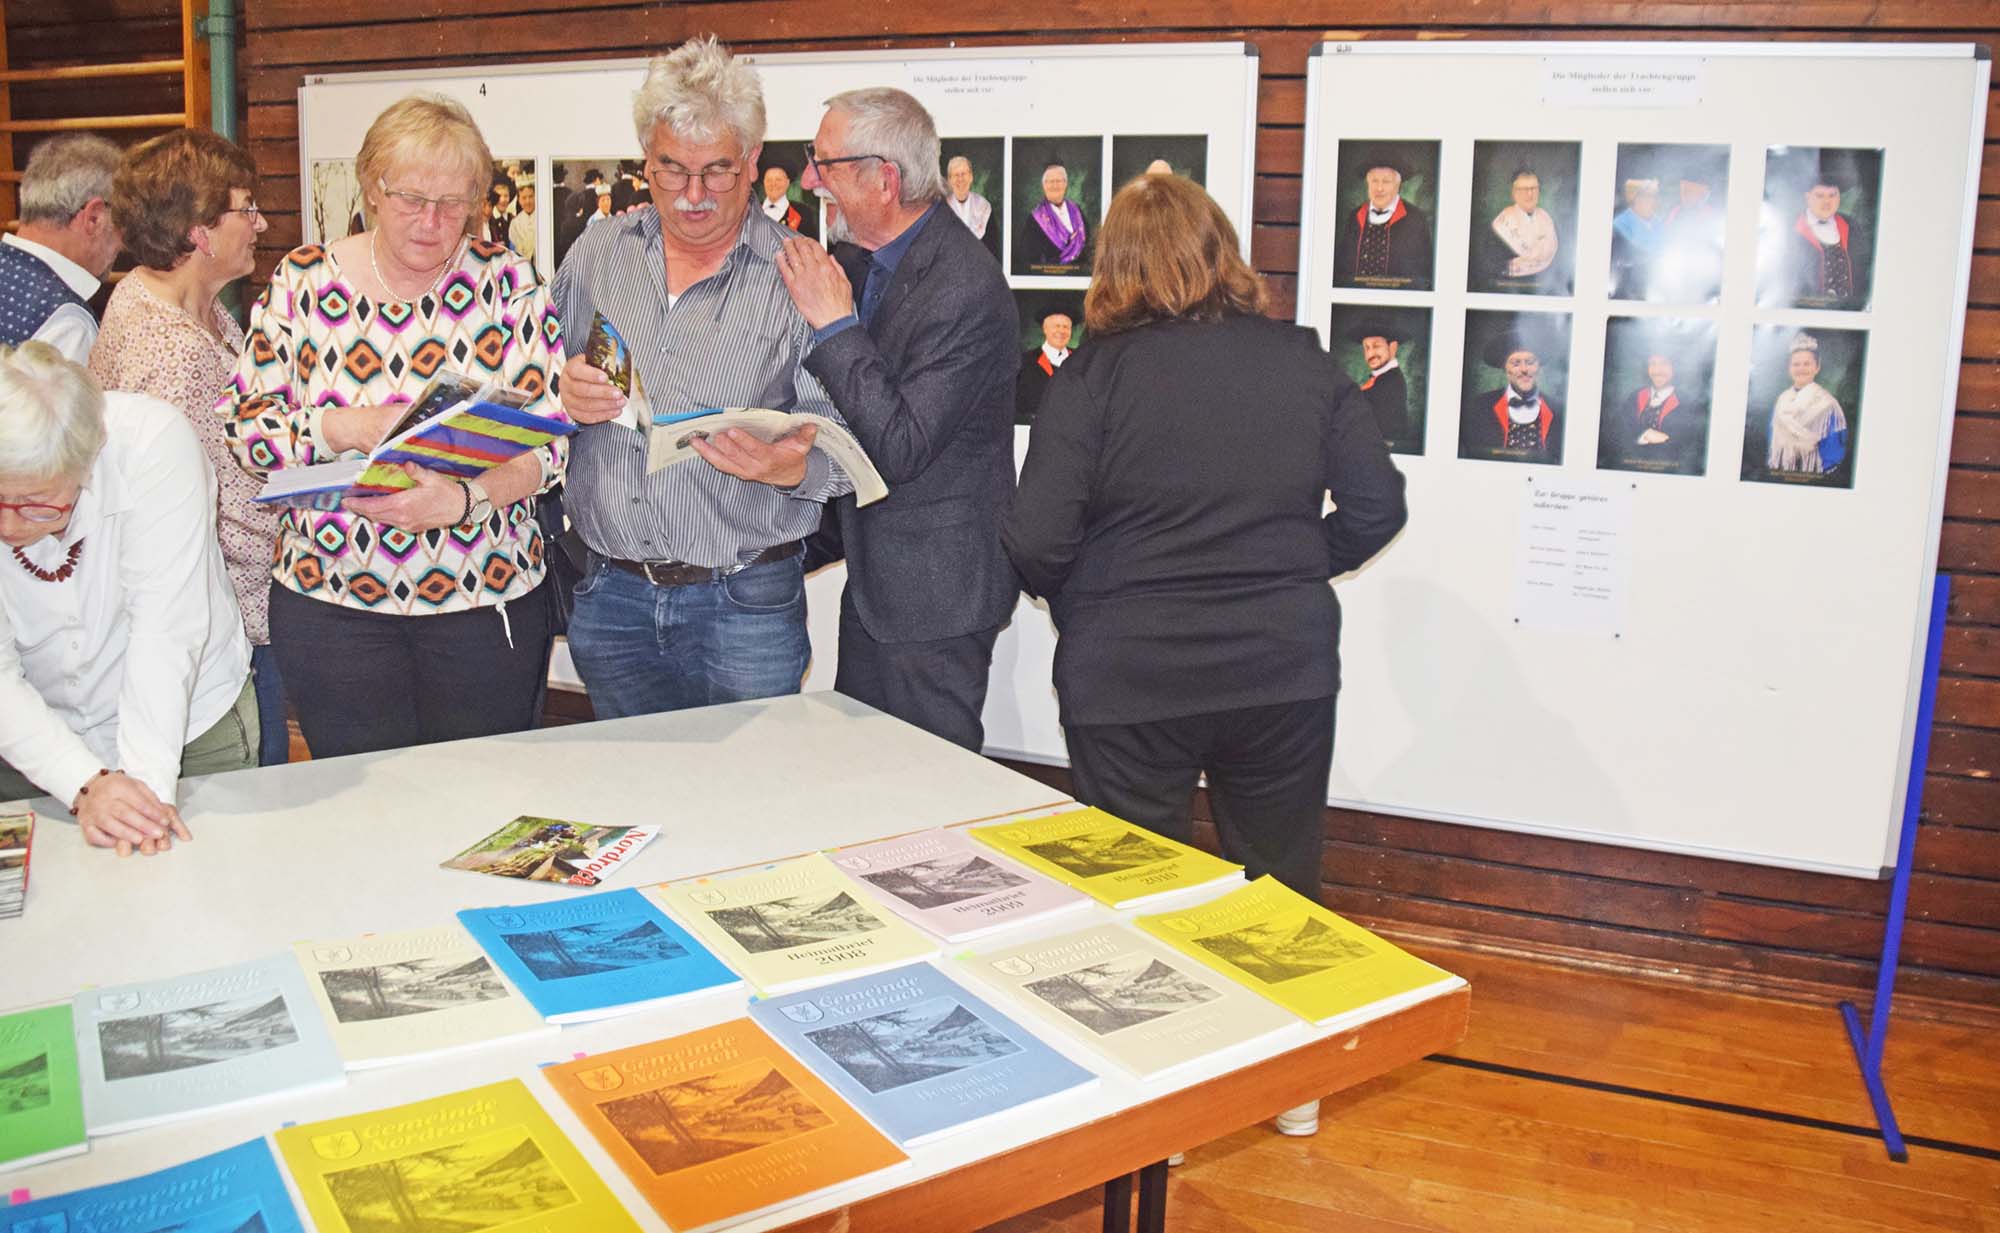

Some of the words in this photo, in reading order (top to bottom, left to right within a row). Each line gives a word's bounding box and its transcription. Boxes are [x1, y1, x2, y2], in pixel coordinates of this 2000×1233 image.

[478, 82, 487, 97] 4
[1113, 862, 1181, 884] Heimatbrief
[1139, 871, 1180, 887] 2010
[952, 890, 1028, 914] Heimatbrief
[979, 900, 1026, 917] 2009
[785, 936, 876, 963] Heimatbrief
[815, 949, 868, 966] 2008
[1024, 932, 1112, 963] Gemeinde
[816, 974, 921, 1010] Gemeinde
[829, 986, 926, 1018] Nordrach
[619, 1032, 738, 1074] Gemeinde
[630, 1048, 743, 1086] Nordrach
[362, 1097, 499, 1139] Gemeinde
[370, 1113, 498, 1154] Nordrach
